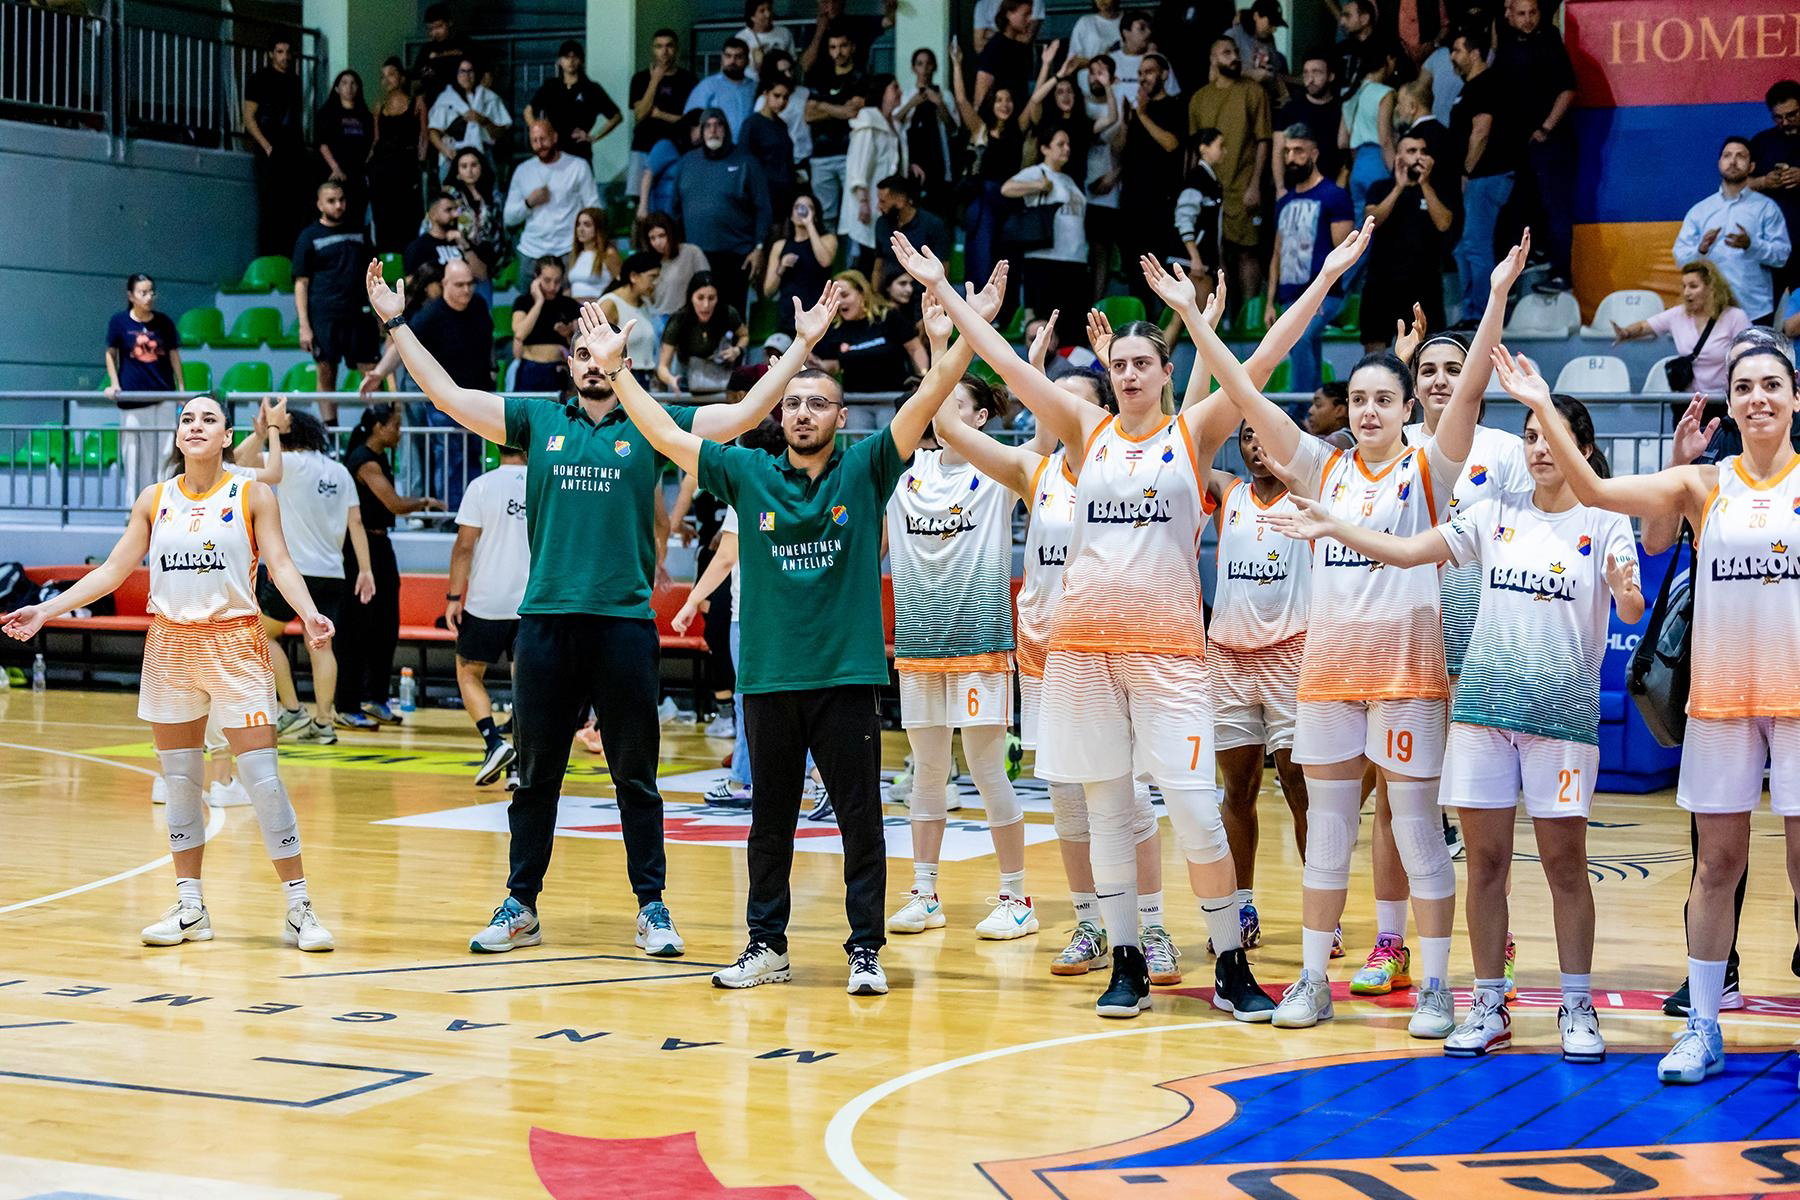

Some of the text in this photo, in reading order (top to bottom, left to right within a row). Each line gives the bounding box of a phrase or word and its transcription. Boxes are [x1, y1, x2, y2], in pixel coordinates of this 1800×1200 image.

[1608, 13, 1800, 65] HOME
[1625, 295, 1642, 306] C2
[553, 464, 621, 480] HOMENETMEN
[1128, 461, 1137, 477] 7
[561, 479, 611, 492] ANTELIAS
[1087, 499, 1172, 524] BARON
[1361, 502, 1374, 517] 19
[189, 518, 201, 533] 10
[905, 510, 978, 536] BARON
[1748, 512, 1768, 529] 26
[1256, 526, 1265, 541] 2
[771, 540, 842, 557] HOMENETMEN
[1038, 544, 1068, 566] BA
[160, 551, 227, 572] BARON
[782, 555, 834, 571] ANTELIAS
[1228, 560, 1288, 580] BARON
[1490, 566, 1577, 601] BARON
[967, 687, 979, 717] 6
[1186, 735, 1201, 771] 7
[1387, 729, 1413, 763] 19
